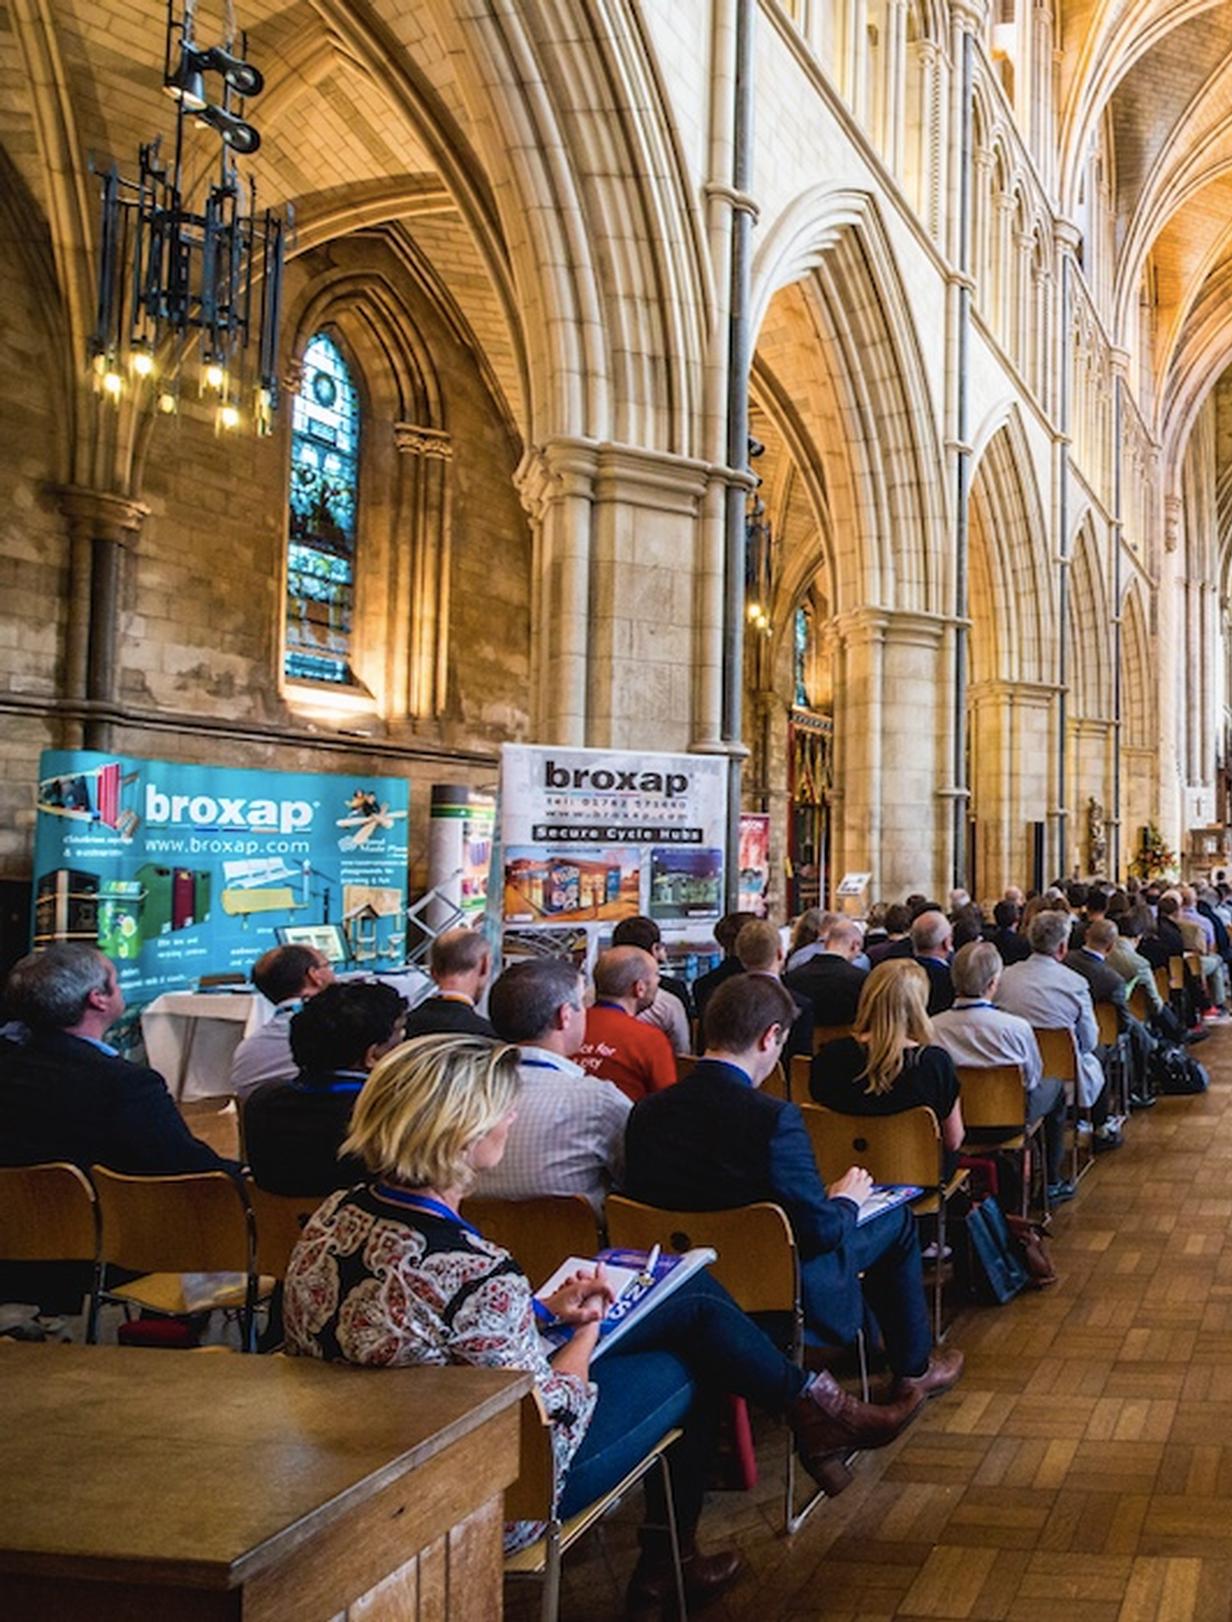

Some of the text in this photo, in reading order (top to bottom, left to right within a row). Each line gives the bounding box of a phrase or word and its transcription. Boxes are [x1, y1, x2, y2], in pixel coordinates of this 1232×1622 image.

[545, 760, 689, 799] broxap
[145, 783, 315, 835] broxap
[145, 837, 310, 855] www.broxap.com
[536, 826, 700, 841] Secure Cycle Hubs
